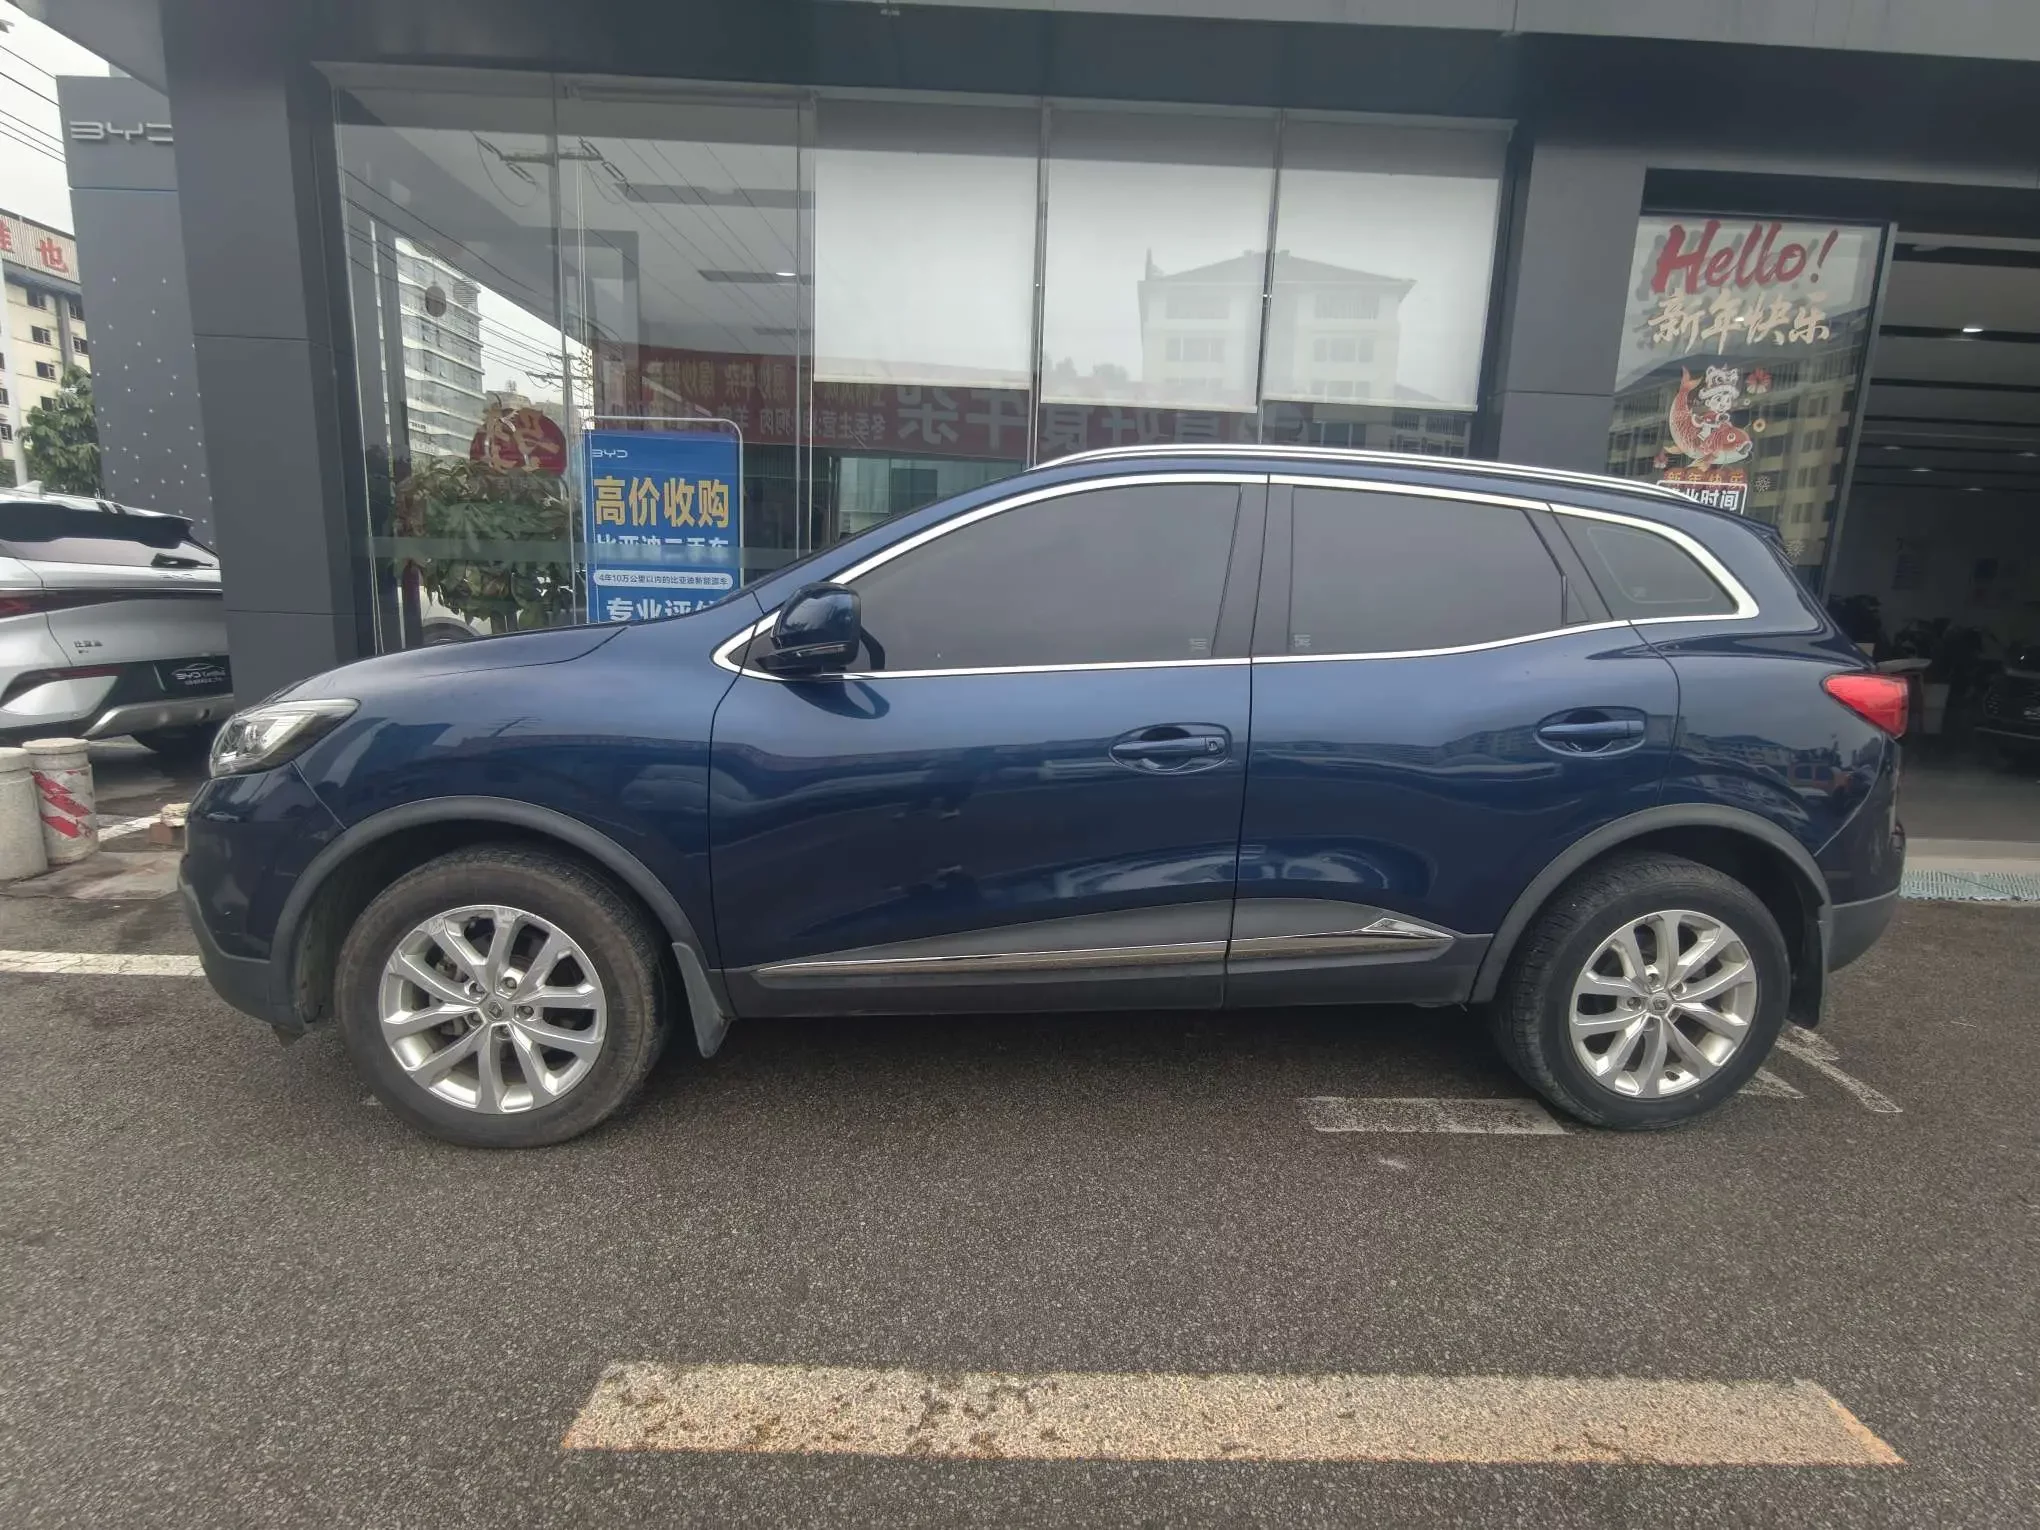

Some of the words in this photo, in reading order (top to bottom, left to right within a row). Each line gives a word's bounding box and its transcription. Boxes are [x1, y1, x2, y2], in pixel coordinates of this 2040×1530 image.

[1651, 219, 1839, 295] Hello!
[1648, 288, 1831, 356] 新年快乐
[592, 449, 628, 458] BYD
[593, 475, 729, 528] 高价收购
[1672, 487, 1740, 511] 业时间
